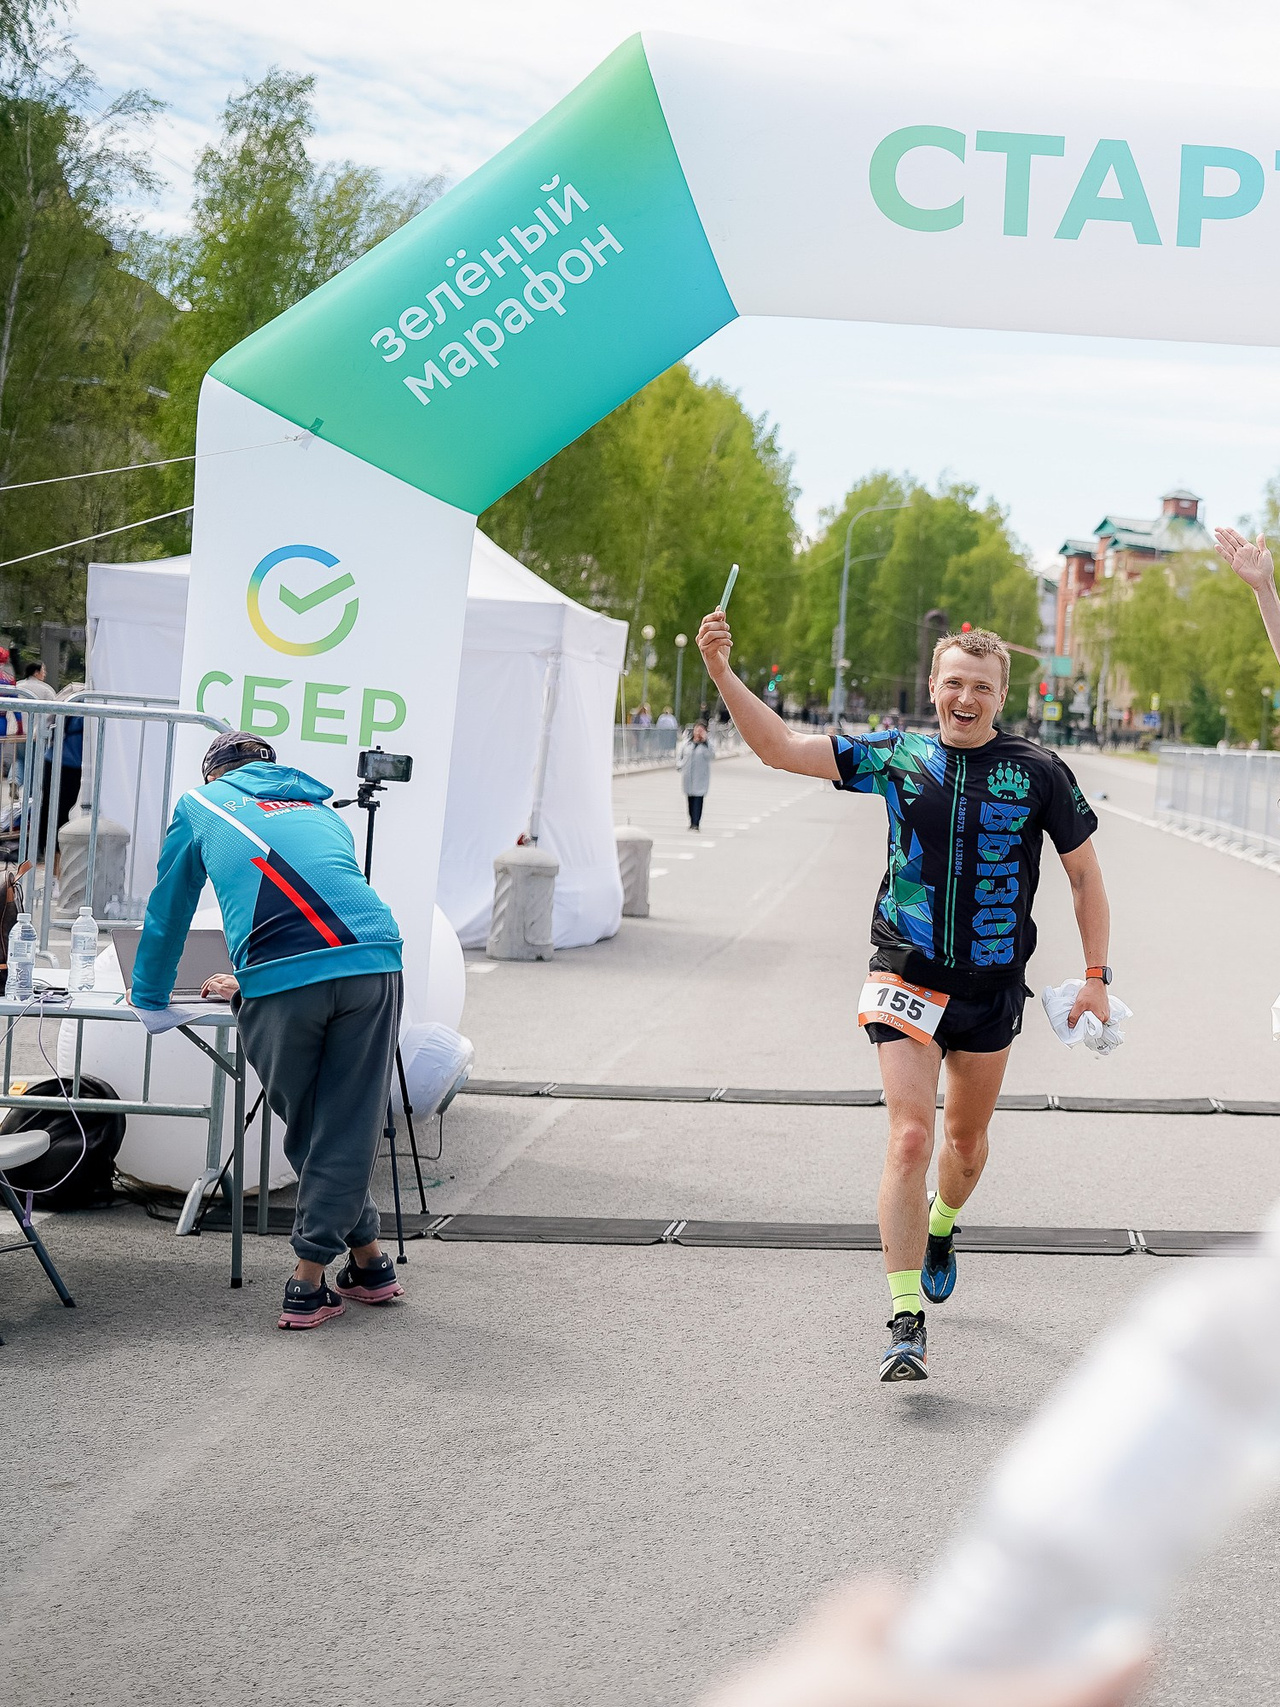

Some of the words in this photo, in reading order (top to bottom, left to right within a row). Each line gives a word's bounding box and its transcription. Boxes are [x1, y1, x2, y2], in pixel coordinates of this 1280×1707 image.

[370, 173, 591, 363] зелёный
[402, 223, 625, 407] марафон
[196, 670, 407, 747] СБЕР
[969, 800, 1031, 967] ВЫЗОВ
[877, 987, 926, 1021] 155
